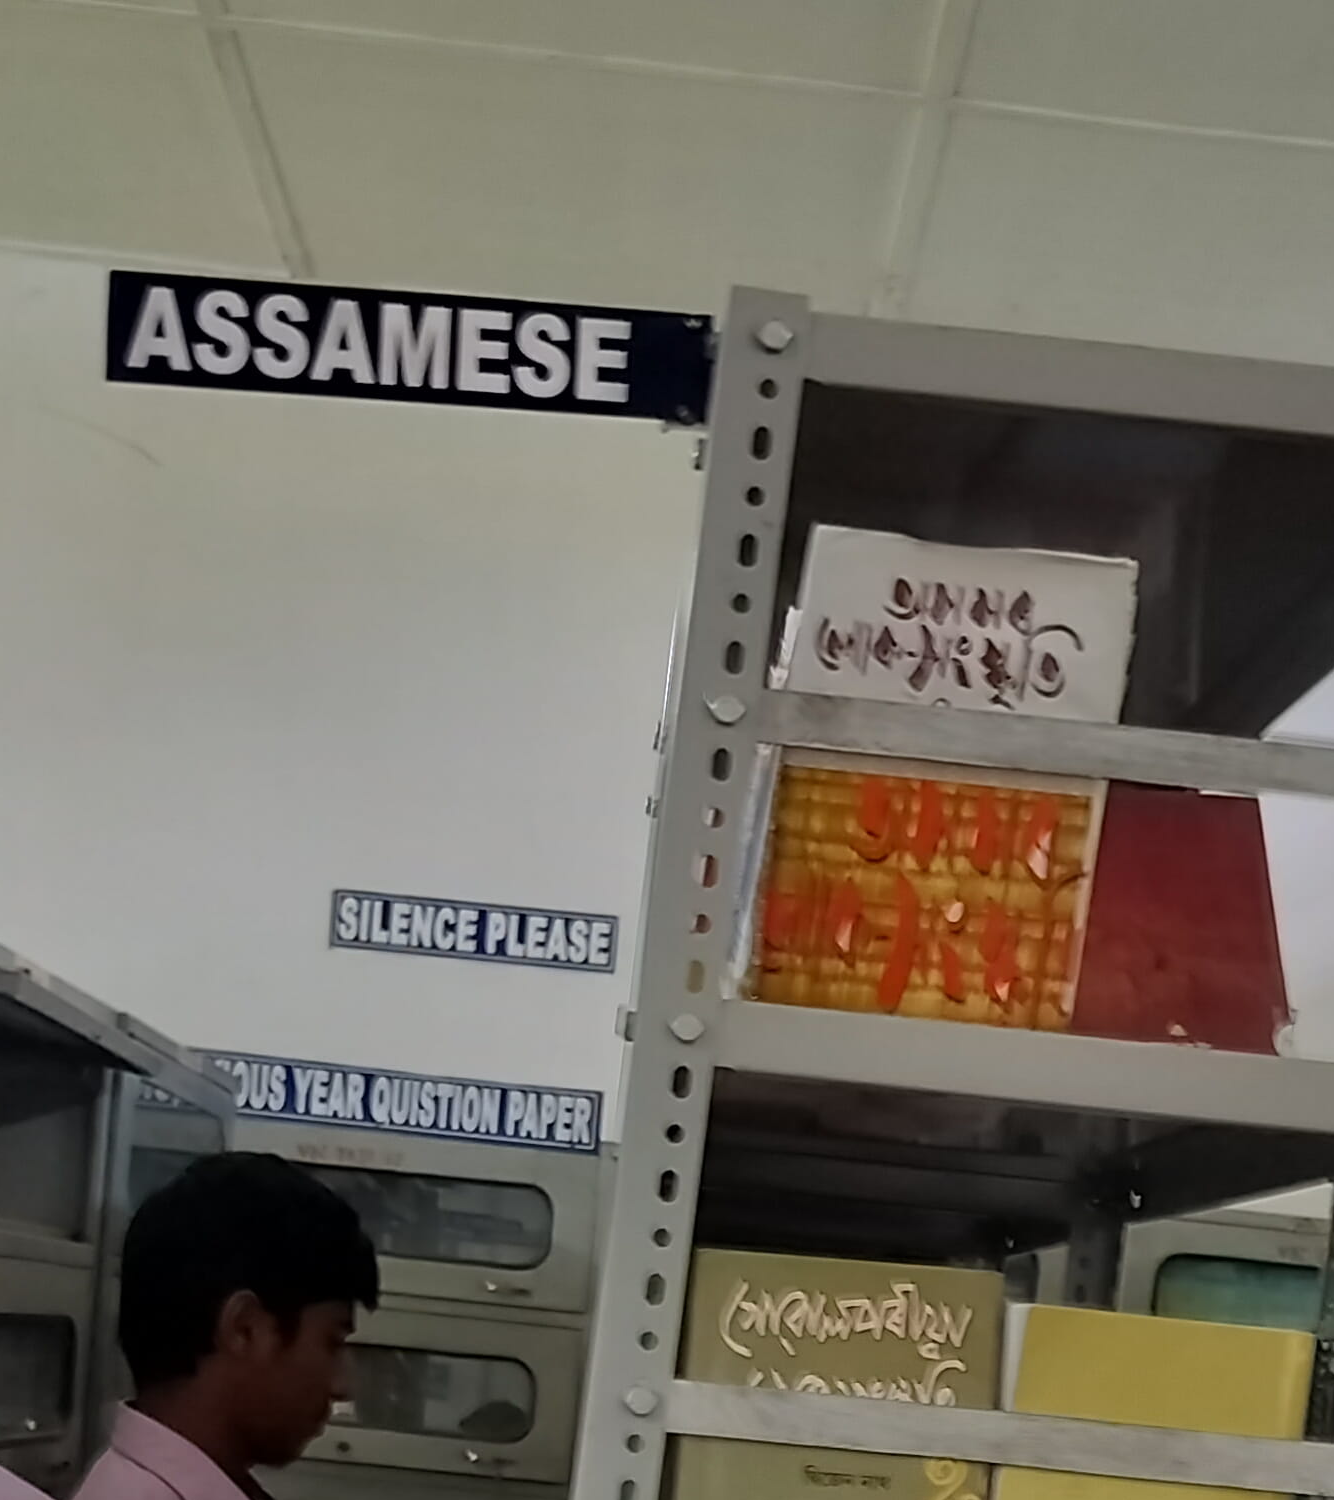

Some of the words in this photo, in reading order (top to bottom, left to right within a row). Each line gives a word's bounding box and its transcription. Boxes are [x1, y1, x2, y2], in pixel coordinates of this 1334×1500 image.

[124, 285, 632, 404] ASSAMESE
[335, 896, 479, 953] SILENCE
[485, 911, 614, 966] PLEASE
[291, 1066, 365, 1121] YEAR
[368, 1075, 503, 1136] QUISTION
[503, 1089, 592, 1145] PAPER
